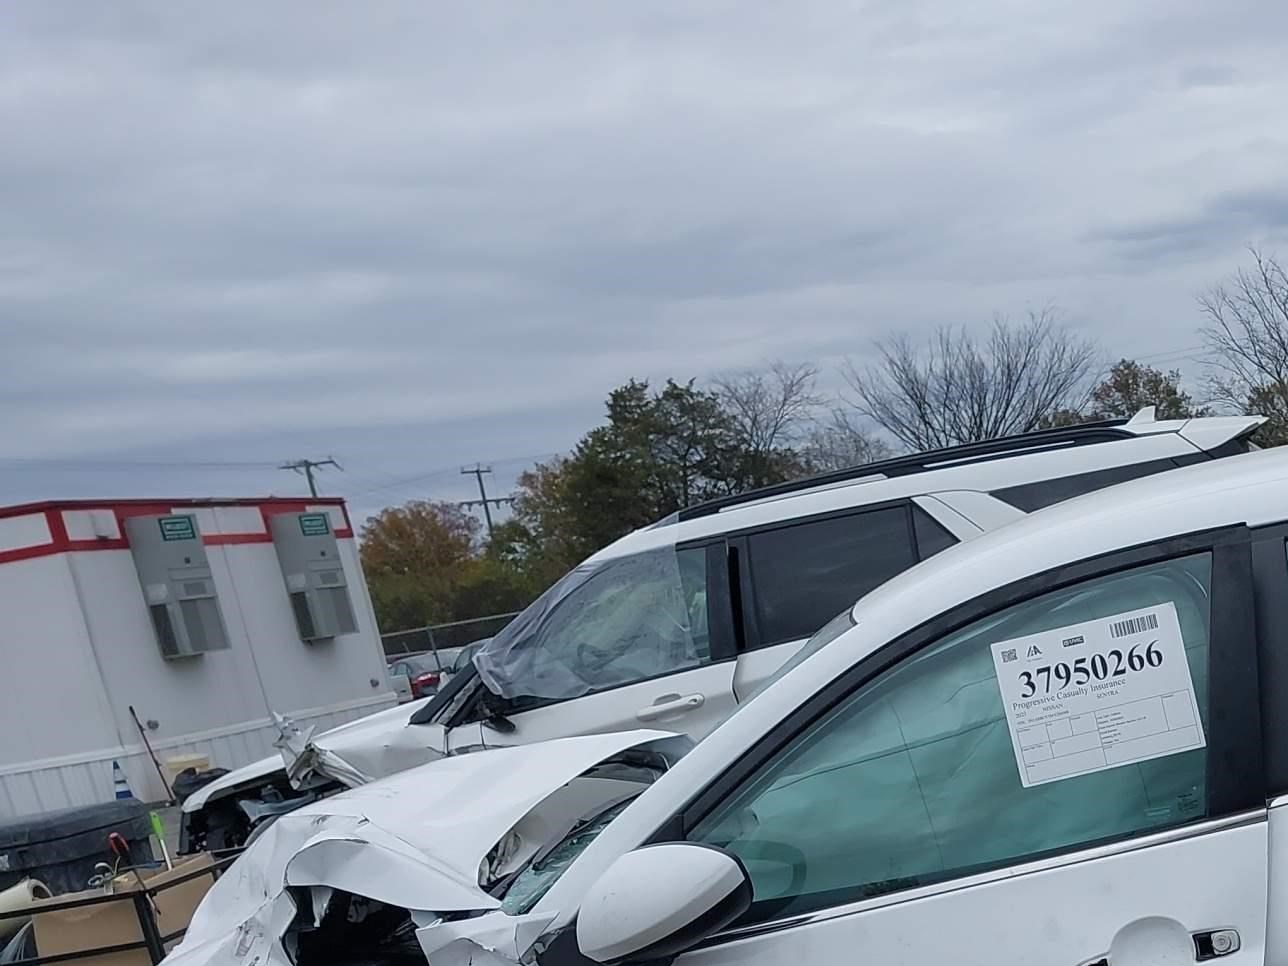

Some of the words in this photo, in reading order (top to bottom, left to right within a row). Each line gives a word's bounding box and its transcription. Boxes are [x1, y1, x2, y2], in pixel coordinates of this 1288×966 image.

[1018, 639, 1163, 698] 37950266
[1012, 695, 1056, 711] Progressive
[1056, 687, 1089, 700] Casualty
[1090, 678, 1126, 692] Insurance
